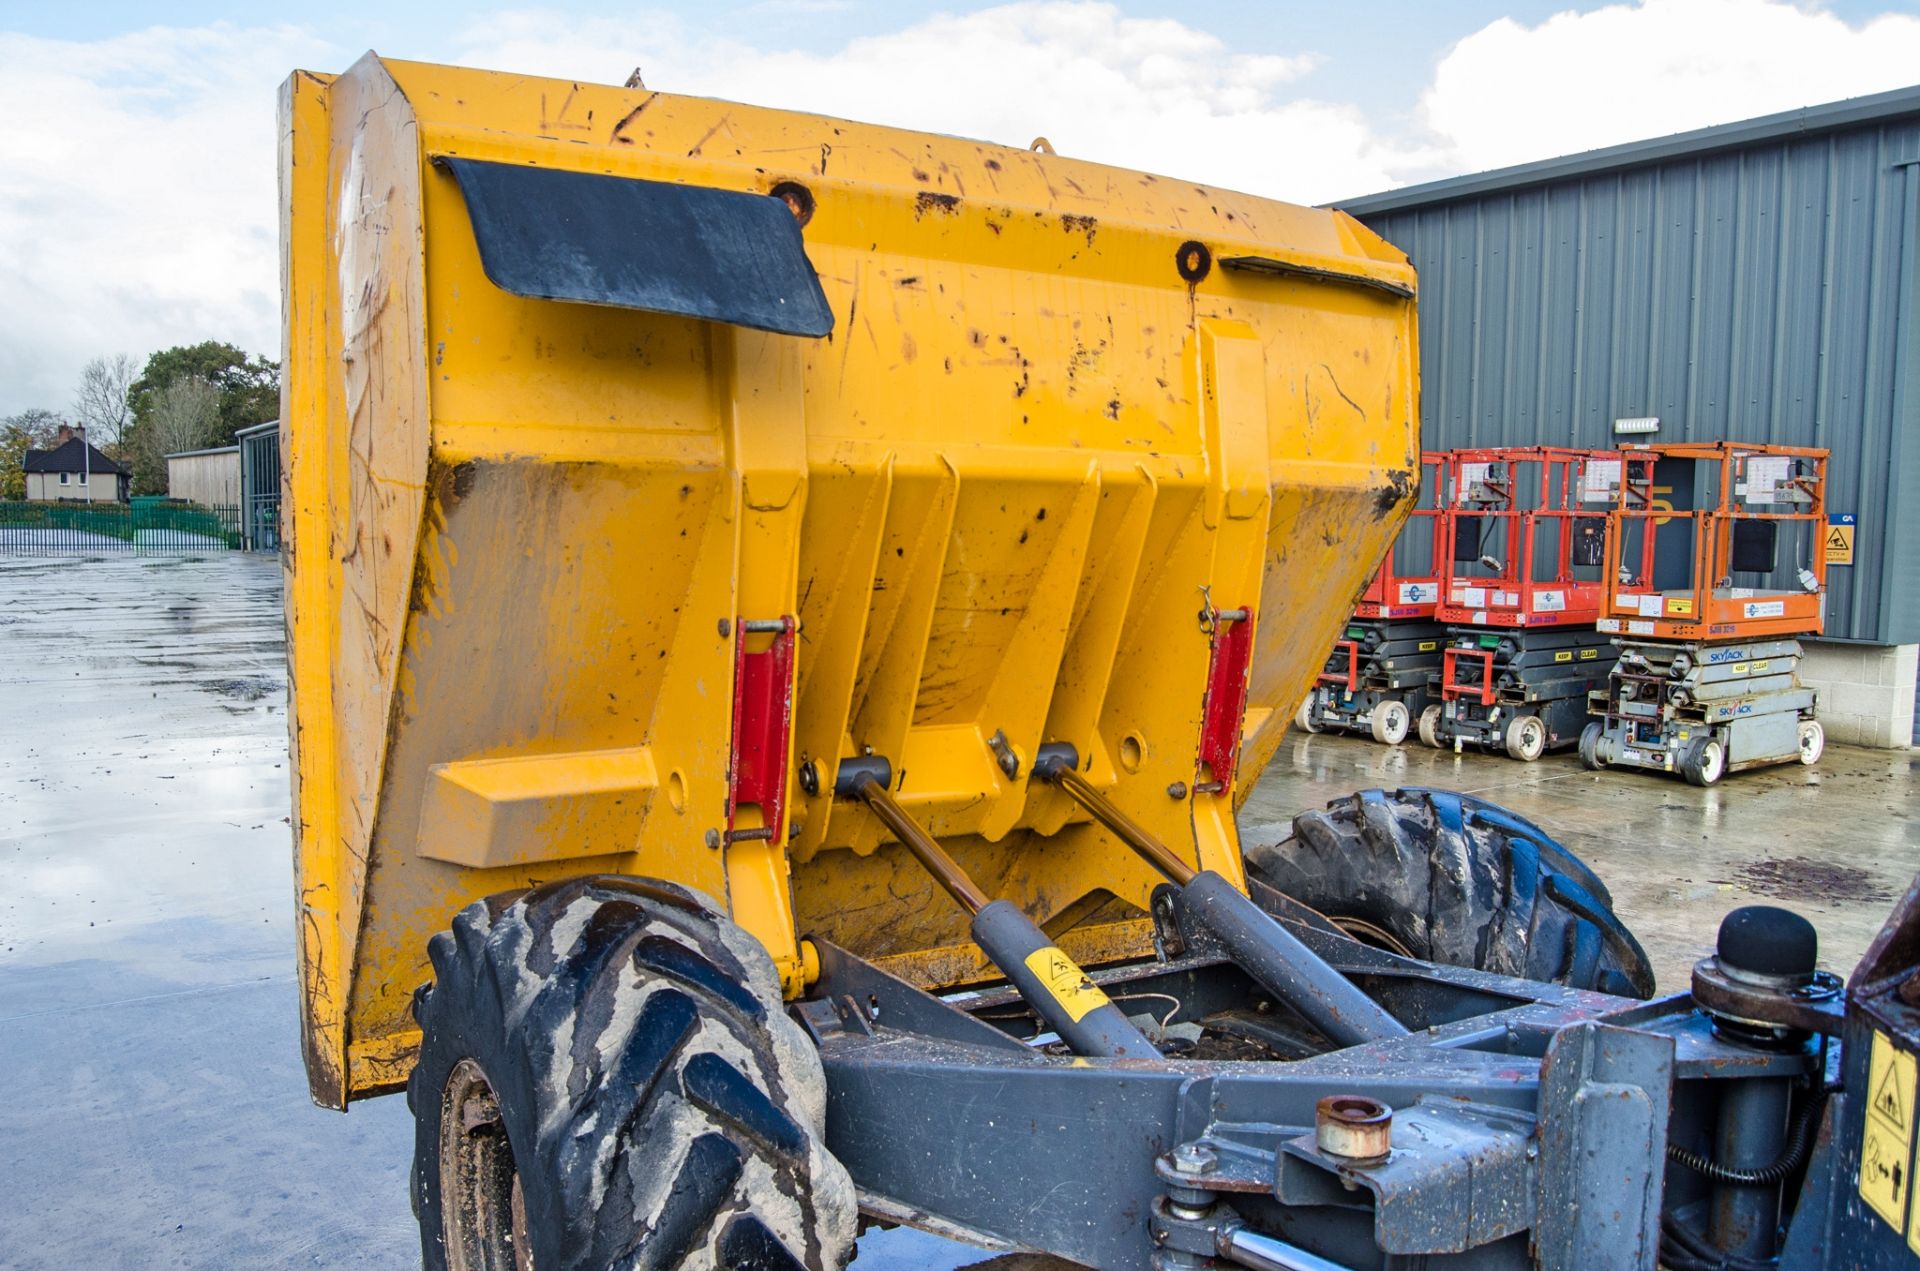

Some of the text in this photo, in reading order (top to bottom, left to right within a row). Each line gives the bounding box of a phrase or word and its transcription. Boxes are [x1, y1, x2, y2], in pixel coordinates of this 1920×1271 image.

[1581, 650, 1596, 658] CLEAR
[1710, 649, 1743, 662] SKYJACK
[1753, 661, 1767, 670] CLEAR
